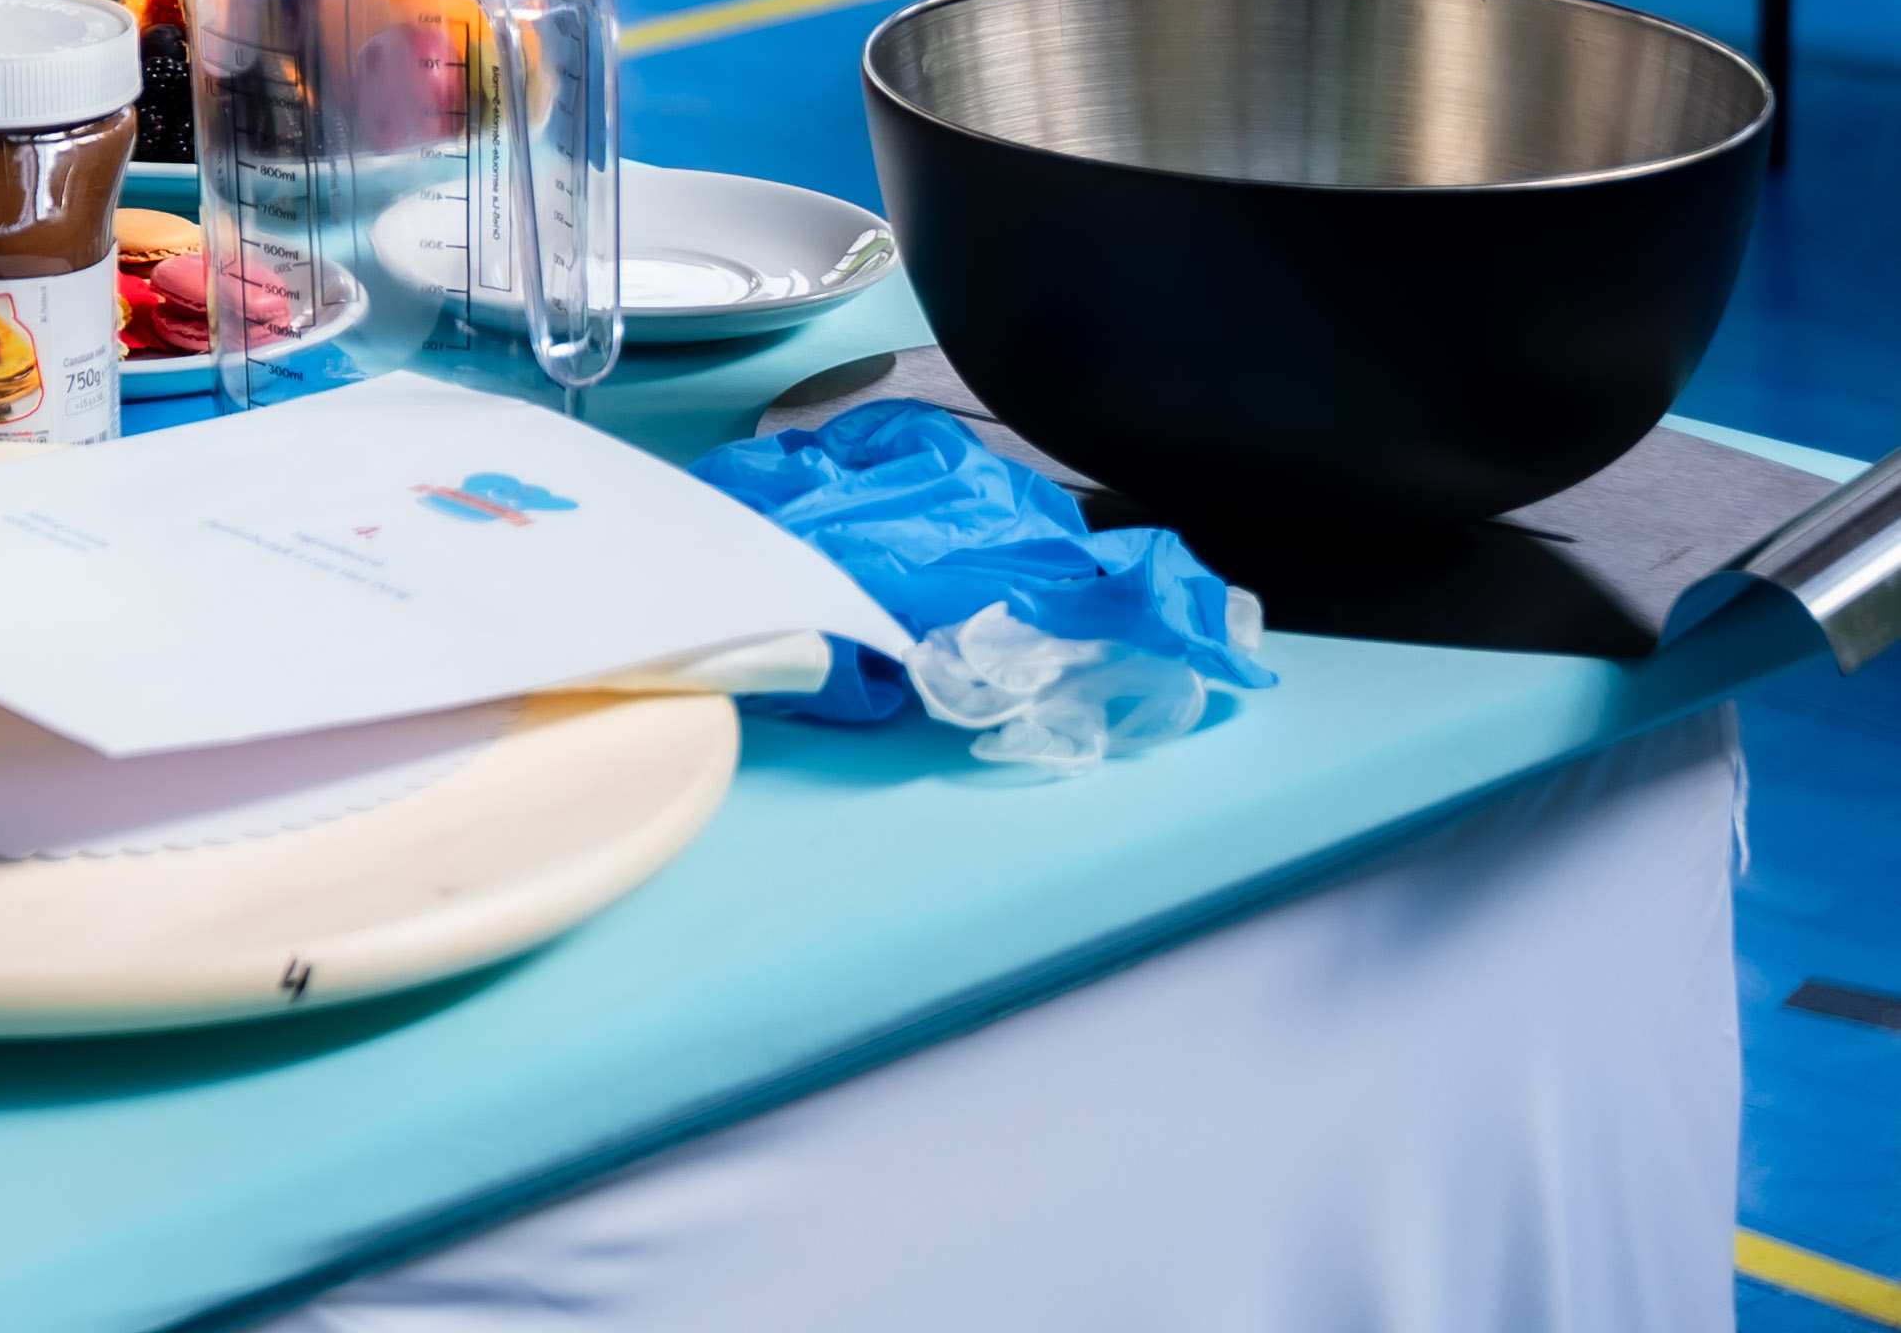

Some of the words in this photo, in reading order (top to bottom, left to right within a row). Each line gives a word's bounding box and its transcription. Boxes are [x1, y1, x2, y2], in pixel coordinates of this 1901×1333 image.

[260, 166, 296, 182] 800ml
[261, 203, 297, 221] 700ml
[263, 244, 299, 260] 600ml
[265, 284, 300, 301] 500ml
[266, 323, 302, 339] 400ml
[65, 367, 101, 394] 750g
[268, 364, 303, 381] 300ml
[280, 955, 313, 1004] 4
